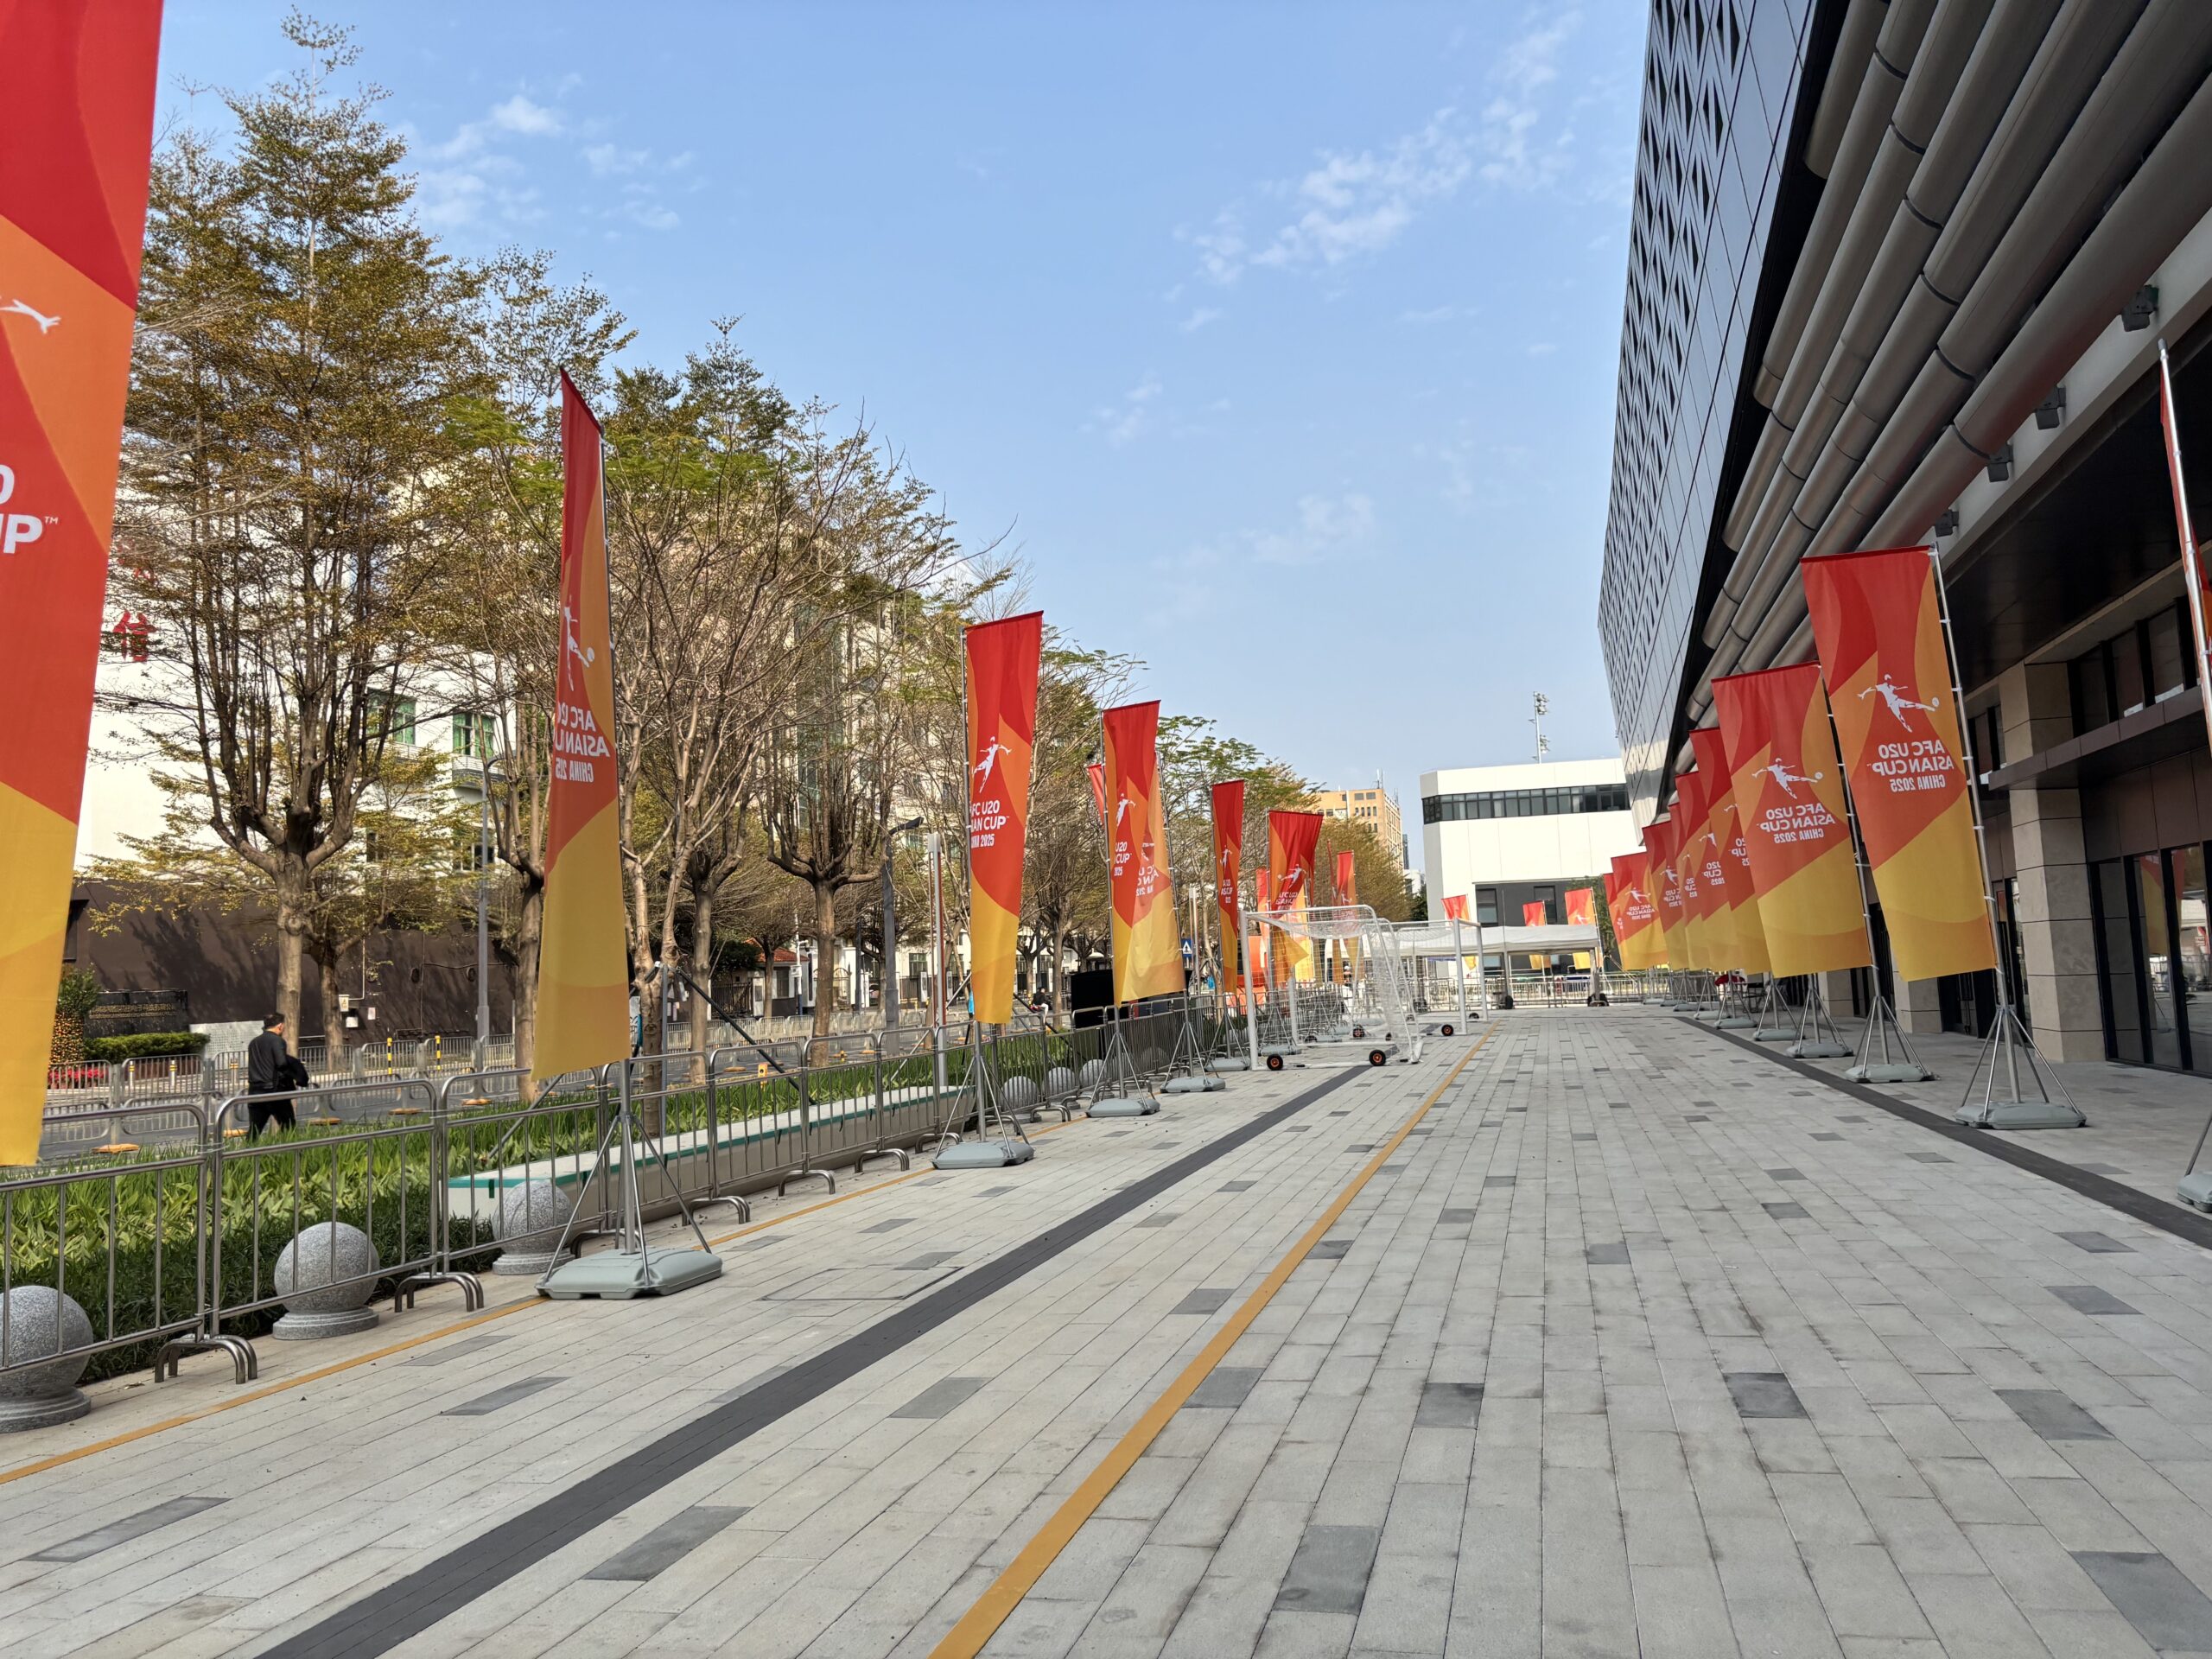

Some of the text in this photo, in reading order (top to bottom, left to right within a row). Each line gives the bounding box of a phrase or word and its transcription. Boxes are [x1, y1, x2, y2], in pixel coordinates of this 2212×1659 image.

[982, 799, 1001, 815] U20
[983, 816, 1007, 830] CUP
[980, 833, 995, 848] 2025
[1116, 853, 1130, 864] CUP
